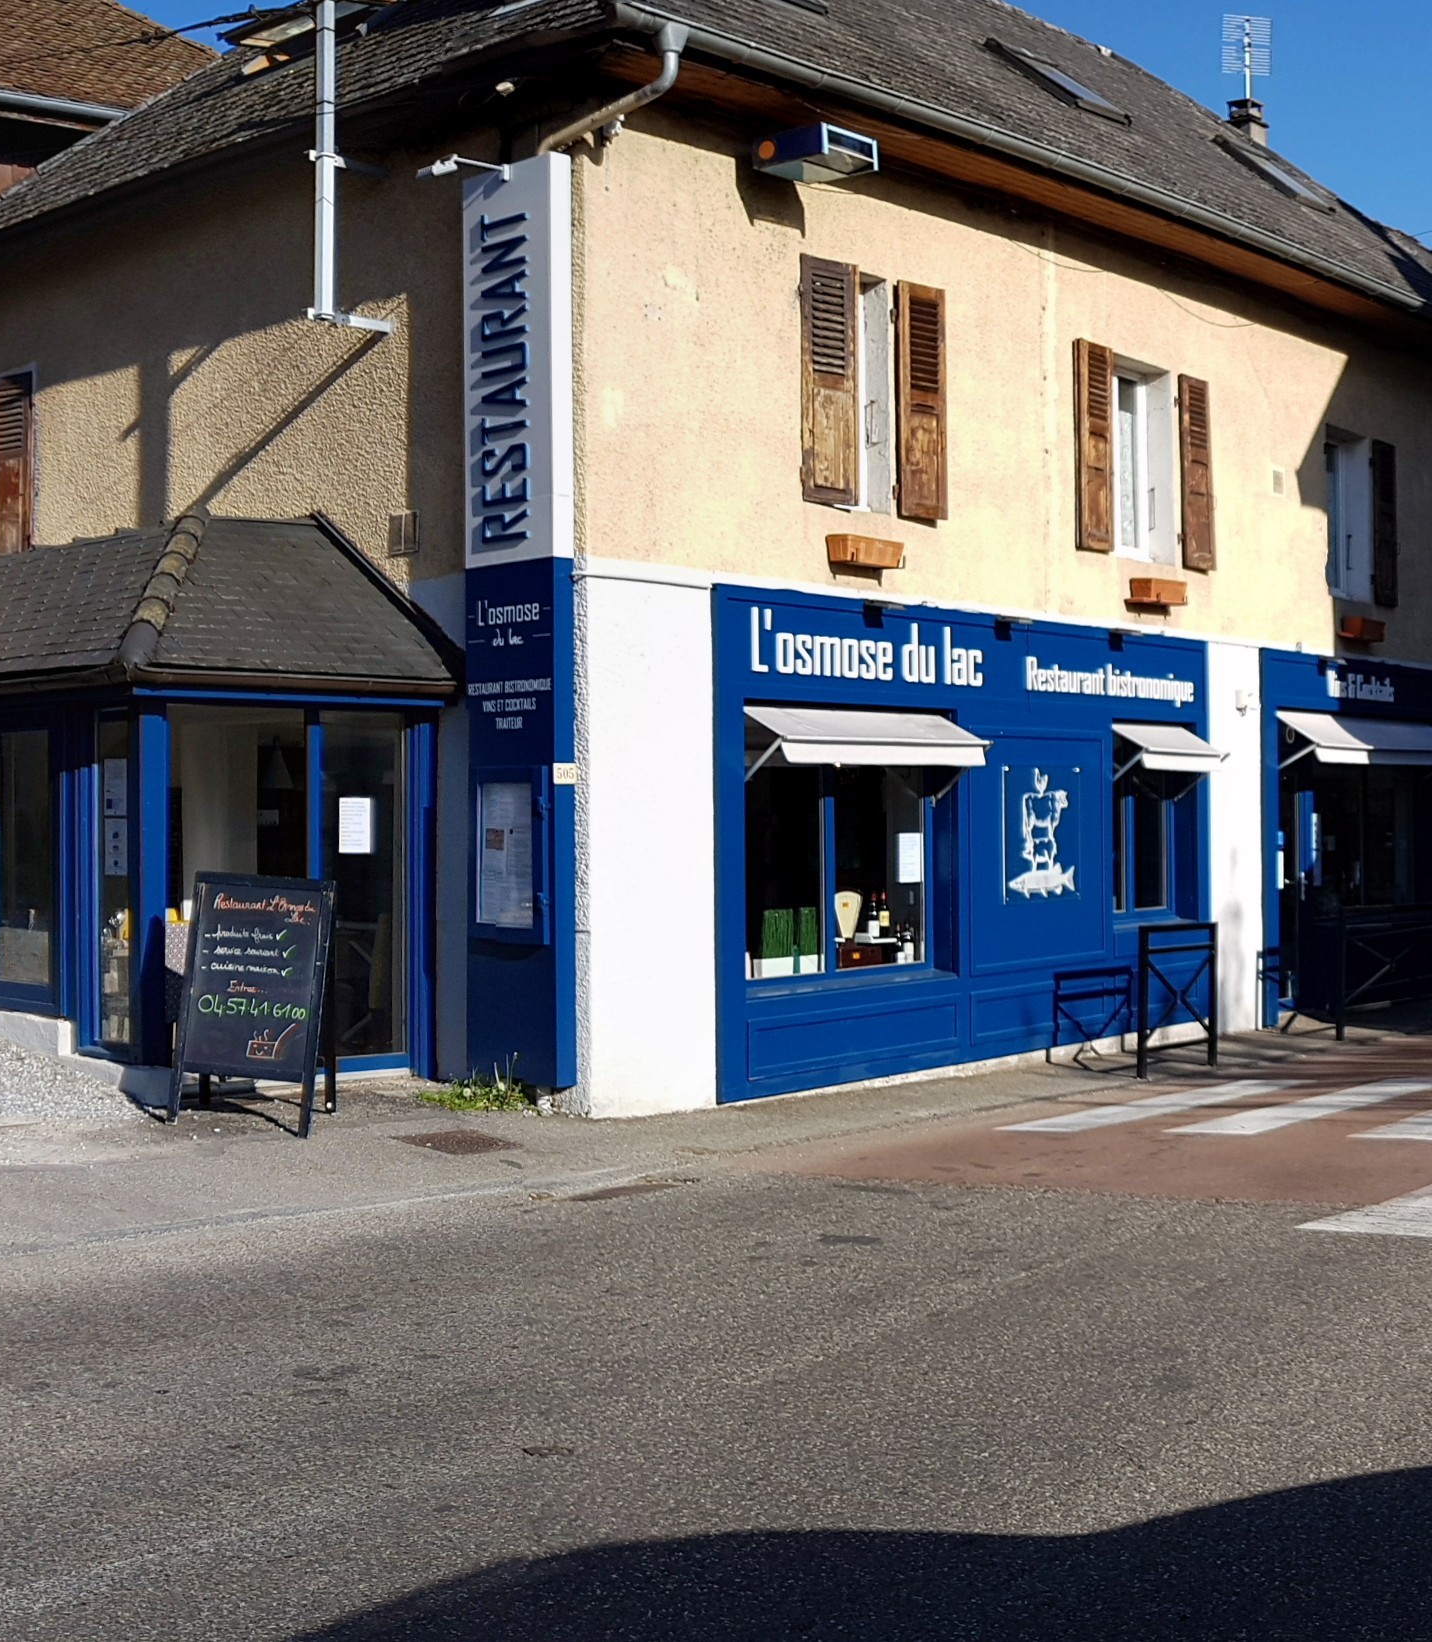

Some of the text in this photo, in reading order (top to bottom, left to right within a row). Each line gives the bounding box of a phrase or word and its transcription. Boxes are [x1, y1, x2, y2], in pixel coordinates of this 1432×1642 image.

[481, 212, 530, 544] RESTAURANT
[477, 600, 540, 626] L'osmose
[492, 628, 524, 646] du lac
[750, 606, 983, 687] L'osmose du lac
[468, 678, 552, 696] RESTAURANT BISTRONOMIQUE
[1025, 655, 1194, 708] Restaurant bistronomique
[483, 700, 496, 712] VINS
[505, 697, 537, 711] COCKTAILS
[495, 716, 523, 730] TRAITEUR
[556, 768, 575, 779] 505
